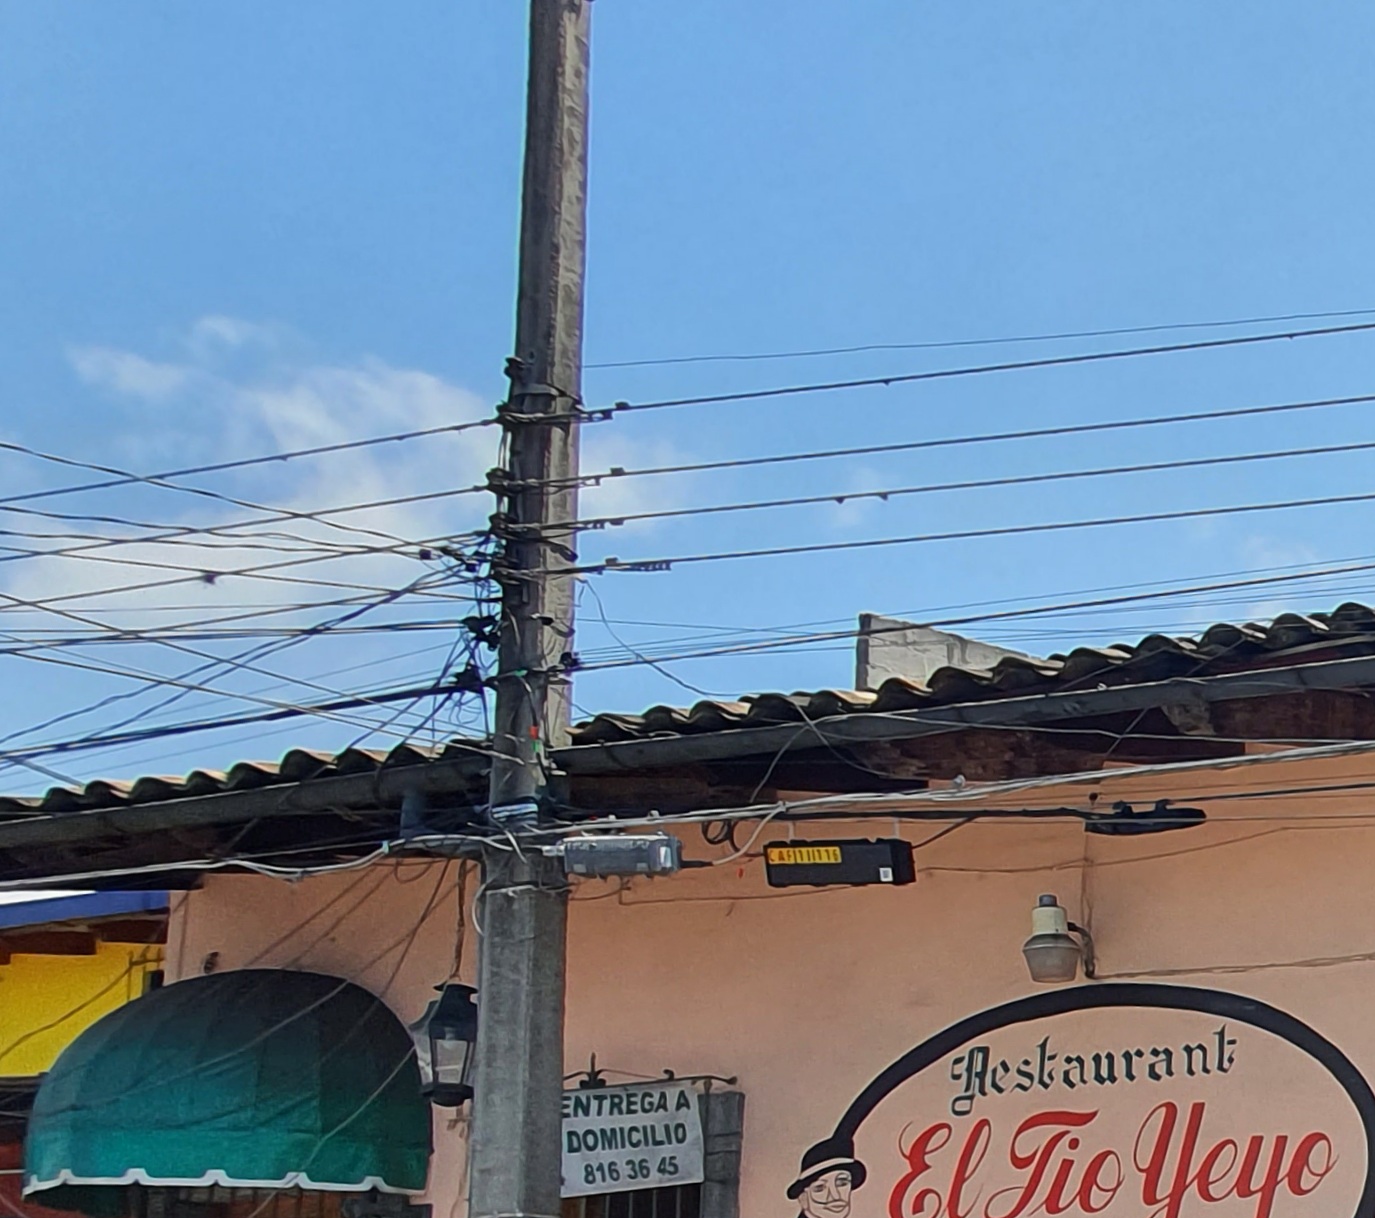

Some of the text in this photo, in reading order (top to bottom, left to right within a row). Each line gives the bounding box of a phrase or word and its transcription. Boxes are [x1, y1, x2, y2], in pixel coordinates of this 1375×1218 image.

[950, 1024, 1238, 1117] Restaurant
[561, 1089, 692, 1119] ENTREGA A
[566, 1122, 688, 1154] DOMICILIO
[583, 1155, 680, 1185] 816 36 45
